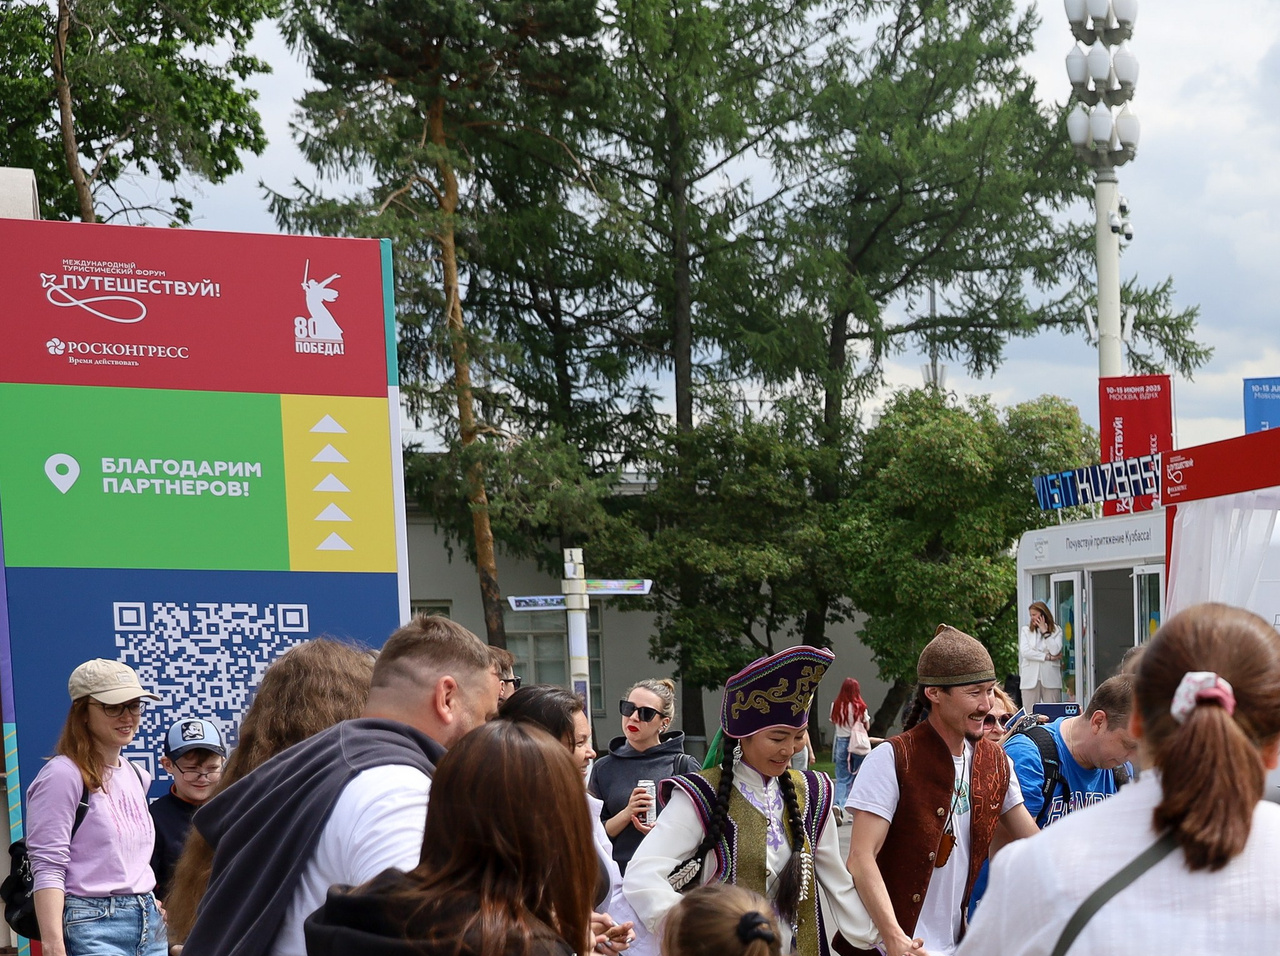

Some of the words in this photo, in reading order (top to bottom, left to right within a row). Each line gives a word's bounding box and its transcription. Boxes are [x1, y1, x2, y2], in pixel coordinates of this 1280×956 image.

[62, 259, 136, 269] МЕЖДУНАРОДНЫЙ
[62, 265, 134, 275] ТУРИСТИЧЕСКИЙ
[135, 269, 166, 277] ФОРУМ
[62, 274, 221, 298] ПУТЕШЕСТВУЙ!
[294, 316, 317, 339] 80
[68, 341, 190, 359] РОСКОНГРЕСС
[295, 341, 345, 356] ПОБЕДА!
[68, 356, 93, 366] Время
[94, 357, 140, 367] действовать
[101, 457, 262, 478] БЛАГОДАРИМ
[103, 477, 250, 497] ПАРТНЕРОВ!
[1032, 471, 1075, 511] VISIT
